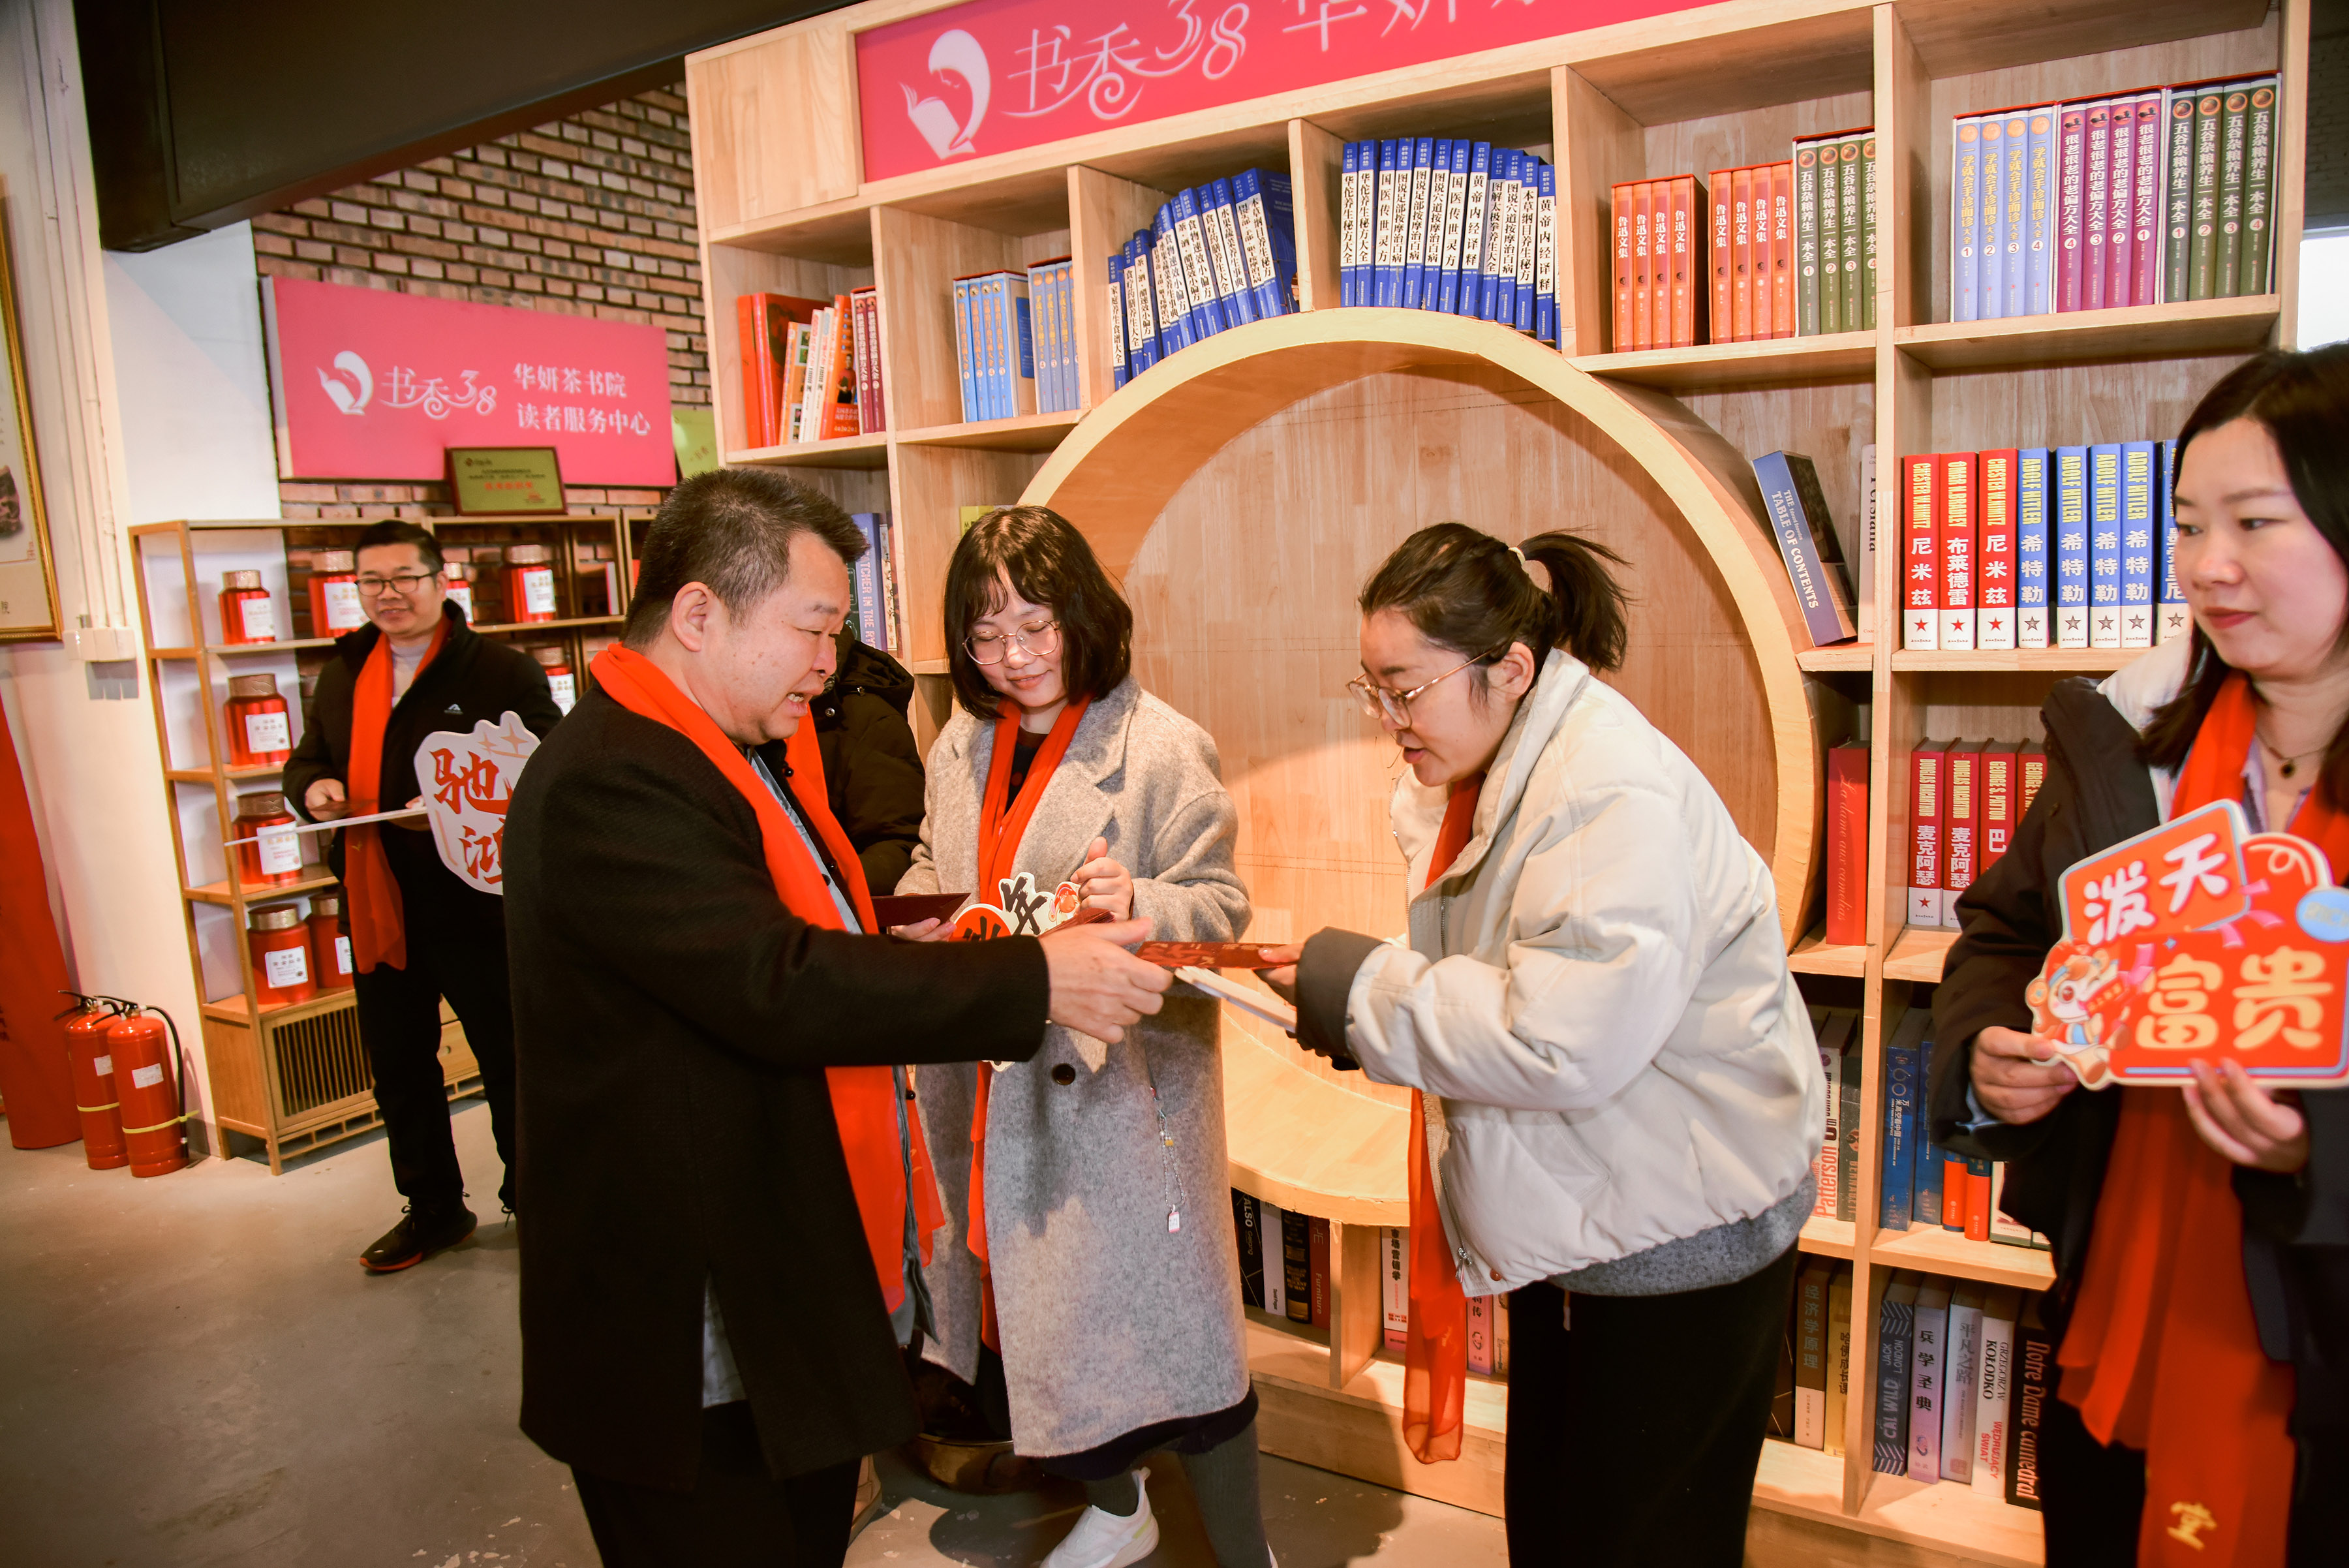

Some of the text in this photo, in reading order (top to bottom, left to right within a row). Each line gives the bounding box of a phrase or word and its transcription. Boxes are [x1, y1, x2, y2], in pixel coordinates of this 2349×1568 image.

[1000, 0, 1248, 120] 书香38
[1961, 148, 1975, 244] 一学就会手诊面诊大全
[1984, 146, 1997, 243] 一学就会手诊面诊大全
[2008, 143, 2021, 241] 一学就会手诊面诊大全
[2032, 140, 2046, 238] 一学就会手诊面诊大全
[2063, 134, 2079, 236] 很老很老的老偏方大全
[2088, 130, 2106, 231] 很老很老的老偏方大全
[2111, 127, 2128, 230] 很老很老的老偏方大全
[2136, 124, 2153, 226] 很老很老的老偏方大全
[2171, 122, 2188, 222] 五谷杂粮养生一本全
[2196, 119, 2215, 220] 五谷杂粮养生一本全
[2223, 115, 2243, 217] 五谷杂粮养生一本全
[2249, 111, 2269, 214] 五谷杂粮养生一本全
[1251, 198, 1271, 277] 本草纲目养生秘方
[1343, 176, 1354, 264] 华佗养生秘方大全
[1359, 173, 1370, 262] 华佗养生秘方大全
[1378, 172, 1391, 262] 国医传世灵方
[1392, 173, 1407, 263] 图说足部按摩治百病
[1409, 170, 1427, 261] 图说足部按摩治百病
[1427, 172, 1446, 263] 图说穴道按摩治百病
[1445, 176, 1463, 267] 国医传世灵方
[1465, 174, 1484, 266] 黄帝内经译释
[1486, 182, 1501, 273] 图解太极拳养生大全
[1502, 183, 1518, 274] 图说穴道按摩治百病
[1520, 190, 1533, 281] 本草纲目养生秘方
[1539, 200, 1552, 290] 黄帝内经译释
[1618, 216, 1629, 258] 鲁迅文集
[1636, 214, 1646, 257] 鲁迅文集
[1655, 212, 1666, 254] 鲁迅文集
[1674, 210, 1685, 253] 鲁迅文集
[1715, 204, 1727, 247] 鲁迅文集
[1736, 202, 1747, 245] 鲁迅文集
[1755, 198, 1767, 242] 鲁迅文集
[1775, 196, 1787, 239] 鲁迅文集
[1800, 171, 1814, 261] 五谷杂粮养生一本全
[1822, 167, 1836, 259] 五谷杂粮养生一本全
[1843, 164, 1856, 257] 五谷杂粮养生一本全
[1165, 234, 1186, 311] 食物速效小偏方
[1188, 219, 1211, 298] 食物速效小偏方
[1206, 213, 1231, 293] 食疗药膳养生大全
[1221, 208, 1244, 286] 水果蔬菜养生事典
[1111, 286, 1122, 363] 家庭养生食谱大全
[1126, 270, 1139, 347] 食疗药膳养生大全
[378, 365, 497, 420] 书香38
[513, 363, 627, 398] 华妍茶书院
[517, 403, 651, 435] 读者服务中心
[1783, 489, 1795, 507] THE
[1912, 463, 1931, 495] CHESTER
[1948, 461, 1967, 485] OMAR
[1988, 458, 2006, 491] CHESTER
[2022, 458, 2042, 525] ADOLF HITLER
[2061, 455, 2082, 523] ADOLF HITLER
[2096, 453, 2116, 522] ADOLF HITLER
[2127, 452, 2148, 519] ADOLF HITLER
[860, 552, 872, 599] ATCHER
[1772, 491, 1819, 609] TABLE OF CONTENTS
[1911, 537, 1933, 606] 尼米兹
[1947, 538, 1969, 606] 布莱德雷
[1986, 534, 2008, 604] 尼米兹
[2021, 534, 2044, 603] 希特勒
[2061, 532, 2084, 602] 希特勒
[2095, 531, 2118, 602] 希特勒
[2125, 529, 2149, 600] 希特勒
[863, 597, 871, 607] IN
[863, 609, 874, 628] THE
[429, 747, 514, 815] 驰
[1919, 758, 1936, 783] DOUGLAS
[1953, 760, 1971, 785] DOUGLAS
[1989, 761, 2006, 782] GEORGE
[1840, 799, 1854, 838] dame
[1989, 829, 2006, 853] 巴
[1916, 825, 1936, 886] 麦克阿瑟
[1950, 827, 1971, 888] 麦克阿瑟
[2083, 833, 2230, 946] 泼天
[2136, 945, 2333, 1051] 富贵
[1243, 1197, 1253, 1227] ALSO
[1814, 1145, 1837, 1218] Patterson
[1804, 1284, 1820, 1369] 经济学原理
[1882, 1342, 1892, 1365] JACK
[1894, 1340, 1904, 1374] LONDON
[2025, 1340, 2051, 1381] Notre
[1916, 1330, 1935, 1411] 兵学圣典
[1982, 1340, 1997, 1400] KOŁODKO
[2000, 1342, 2008, 1389] GRZEGORZ
[2021, 1386, 2046, 1428] Dame
[1979, 1432, 1990, 1463] ŚWIAT
